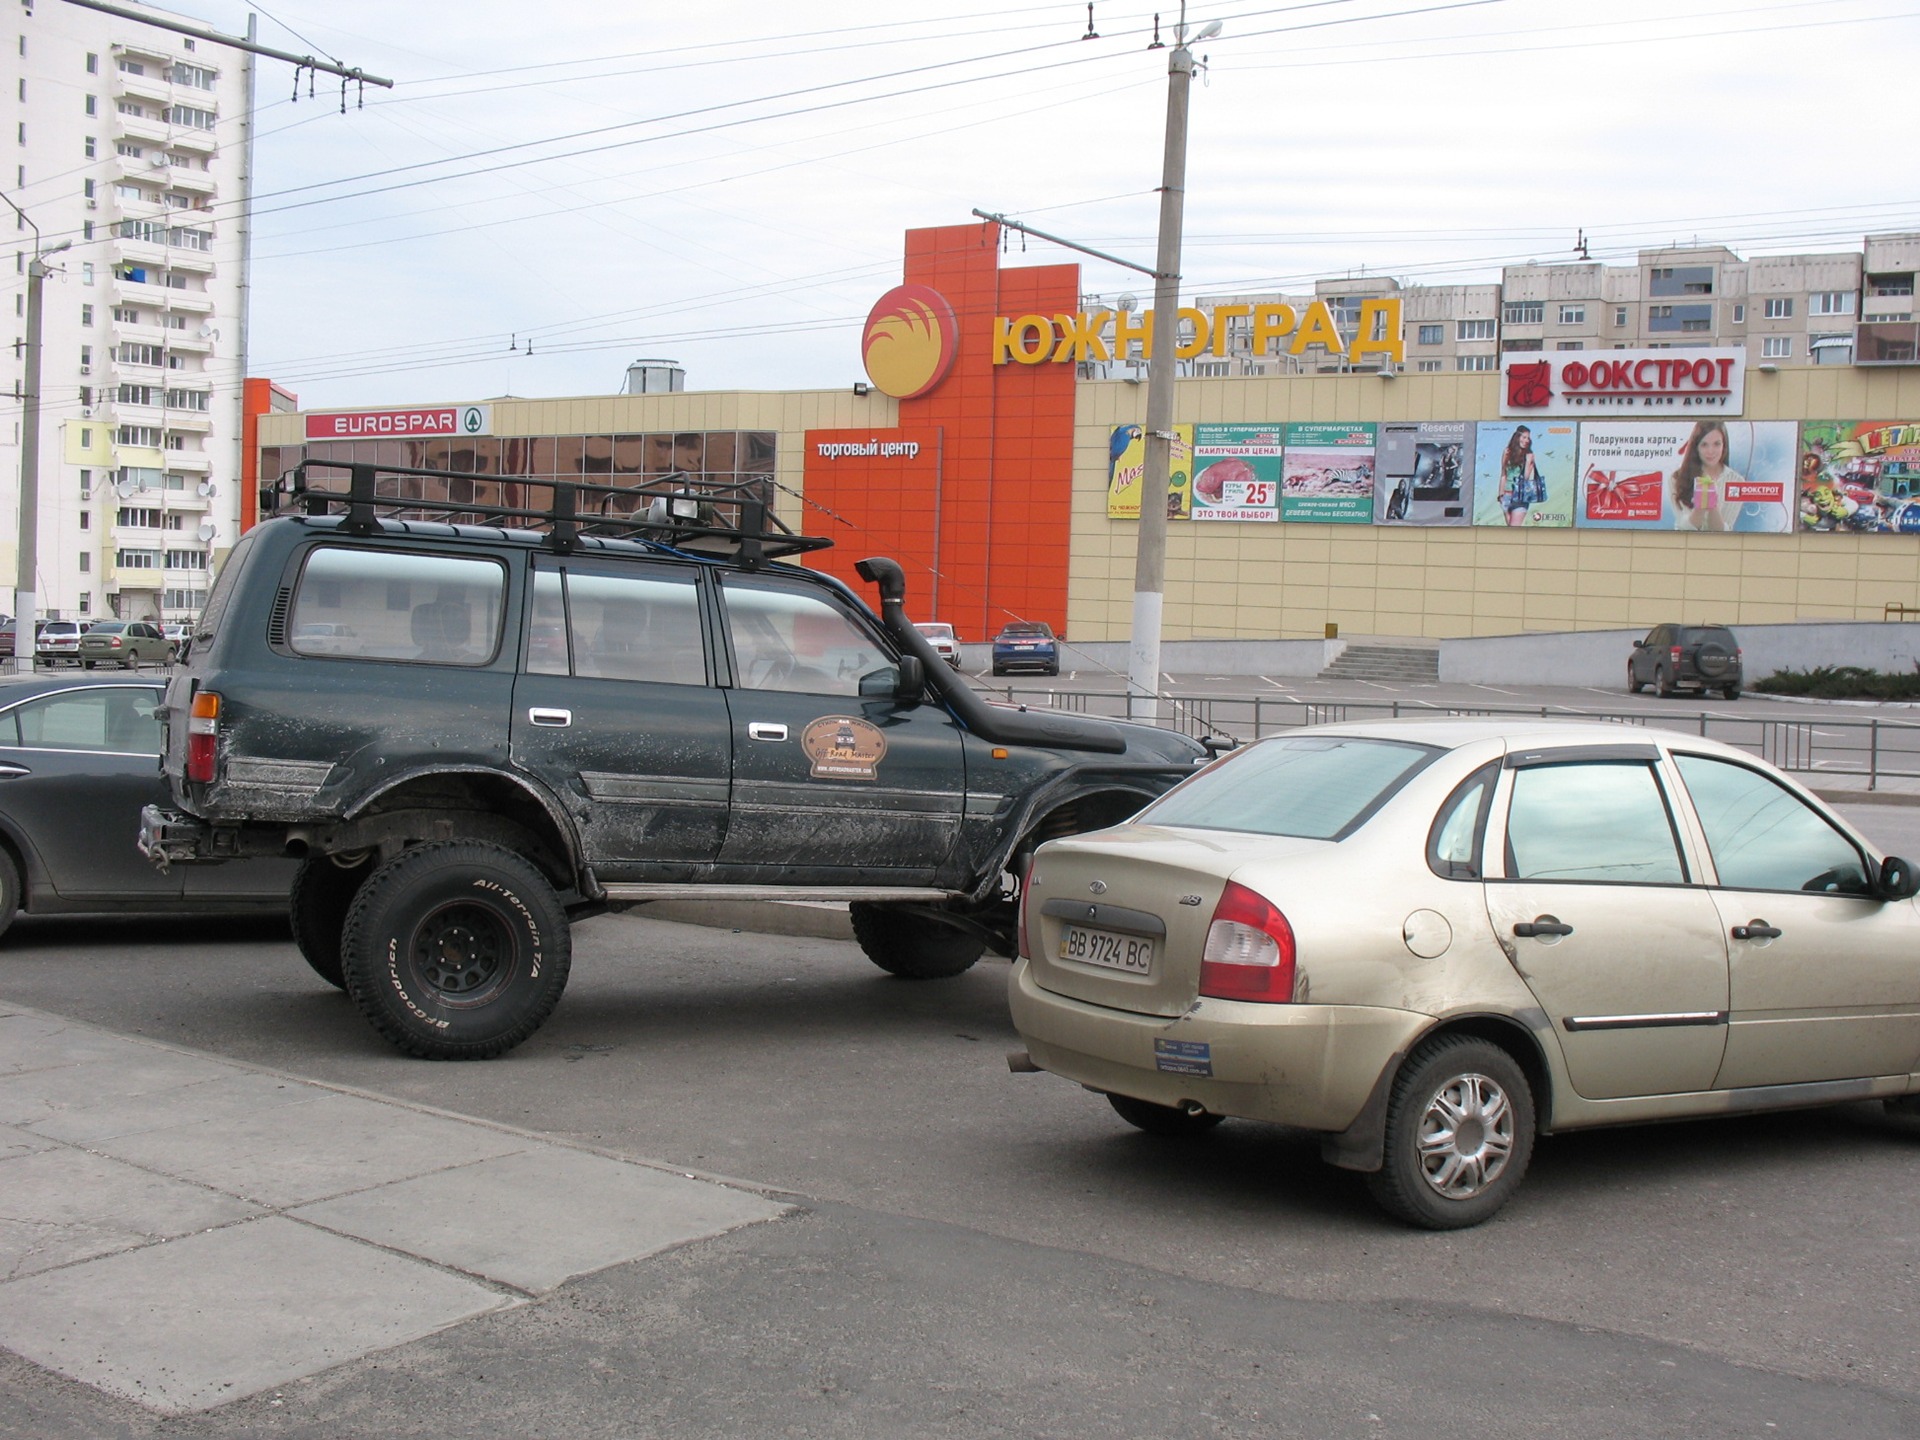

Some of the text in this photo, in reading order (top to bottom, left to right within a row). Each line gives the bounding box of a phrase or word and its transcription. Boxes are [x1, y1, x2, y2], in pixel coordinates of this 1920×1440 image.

[992, 298, 1406, 366] ЮЖНОГРАД
[1561, 358, 1736, 389] ФОКСТРОТ
[1566, 395, 1728, 407] техніка для дому
[334, 413, 453, 433] EUROSPAR
[1420, 423, 1465, 433] Reserved
[817, 438, 919, 460] торговый центр
[1589, 434, 1644, 446] Подарункова
[1647, 436, 1677, 446] картка
[1252, 447, 1278, 456] ЦЕНА!
[1588, 447, 1673, 459] готовий подарунок!
[1246, 483, 1267, 504] 25
[1197, 509, 1273, 519] ЭТО ТВОЙ ВЫБОР!
[1541, 513, 1566, 521] DERBY
[473, 878, 542, 947] All-Terrain
[1067, 930, 1150, 968] BB 9724 BC
[530, 952, 542, 978] T/A
[388, 937, 450, 1029] BFGoodrich
